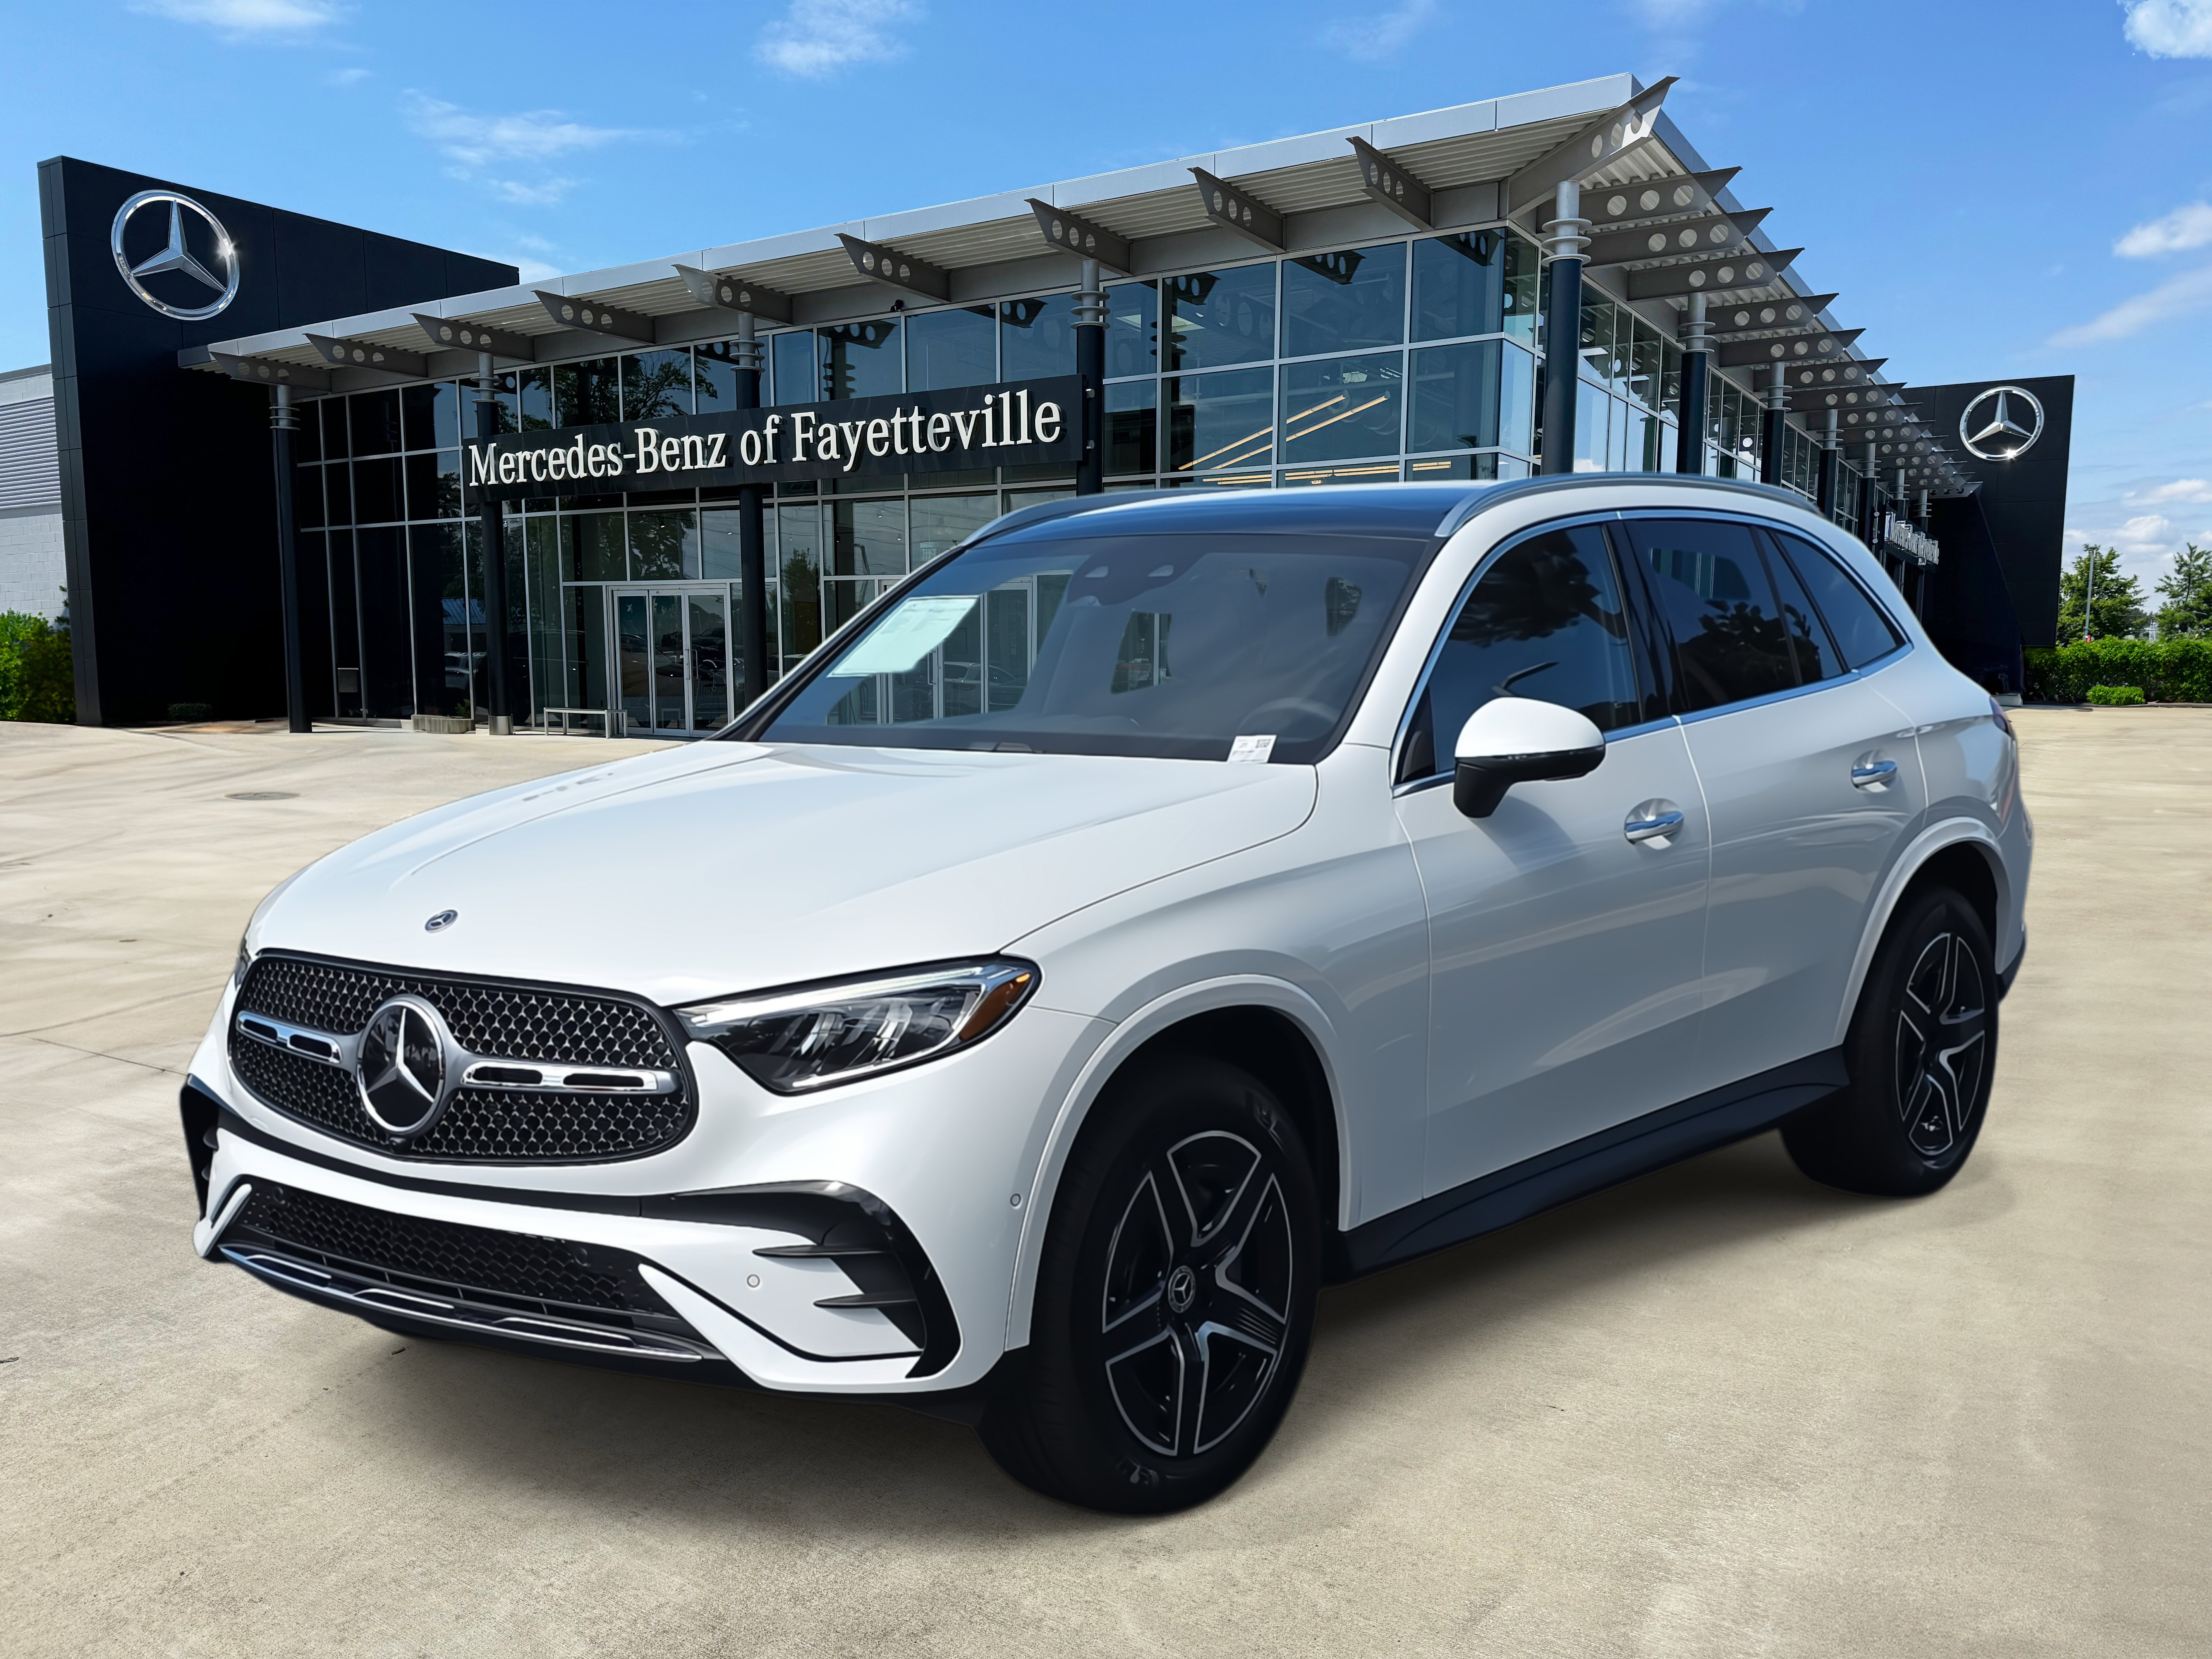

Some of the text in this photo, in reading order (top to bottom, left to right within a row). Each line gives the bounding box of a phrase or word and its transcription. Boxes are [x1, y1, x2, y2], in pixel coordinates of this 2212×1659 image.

[468, 388, 1061, 487] Mercedes-Benz of Fayetteville
